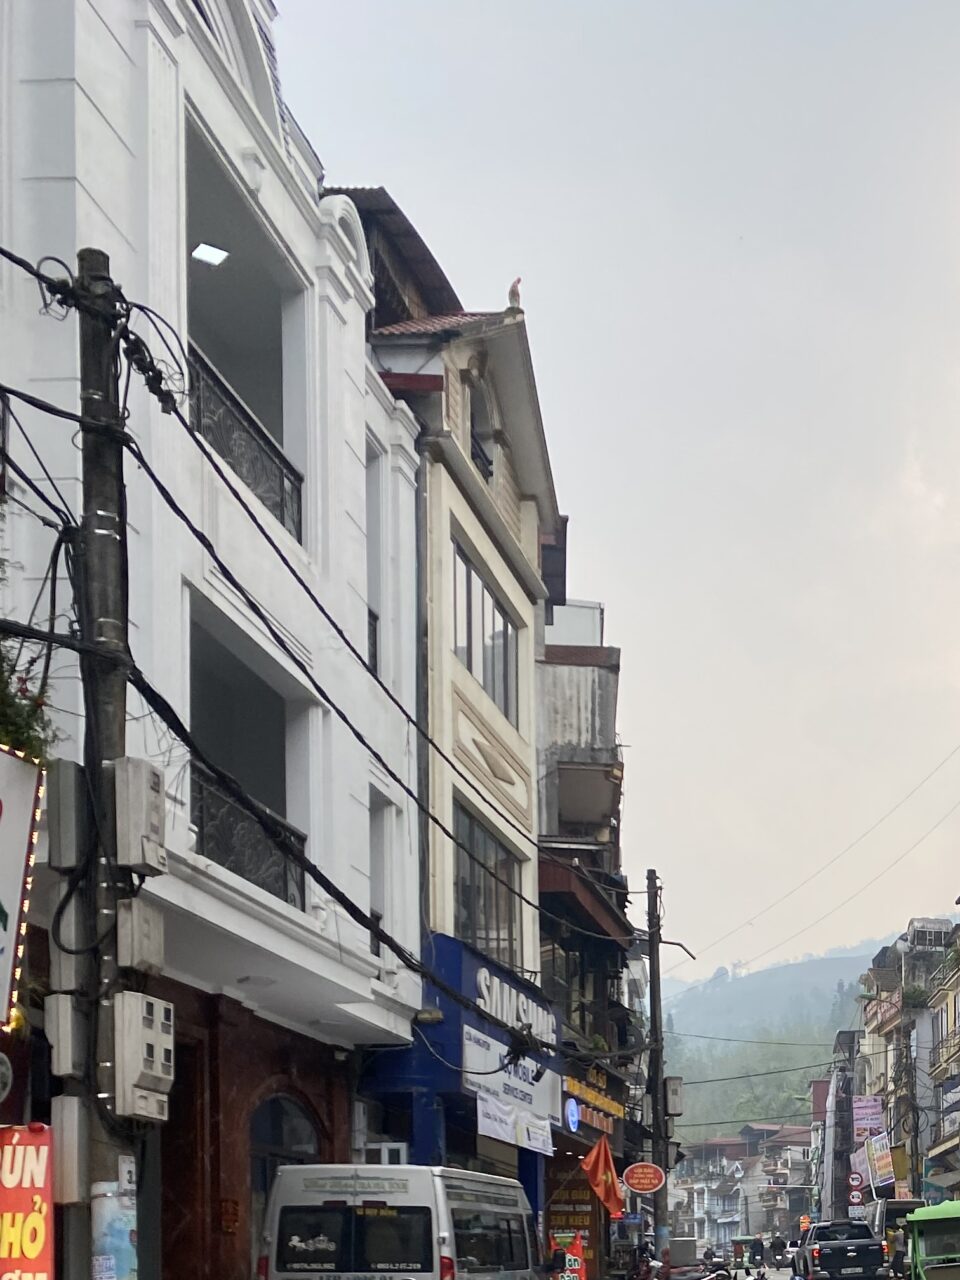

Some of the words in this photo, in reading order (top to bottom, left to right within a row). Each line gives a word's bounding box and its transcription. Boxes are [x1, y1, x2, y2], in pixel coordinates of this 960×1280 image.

[475, 966, 558, 1056] SAMSUNG
[0, 1132, 49, 1189] ÚN
[0, 1194, 48, 1260] HỞ
